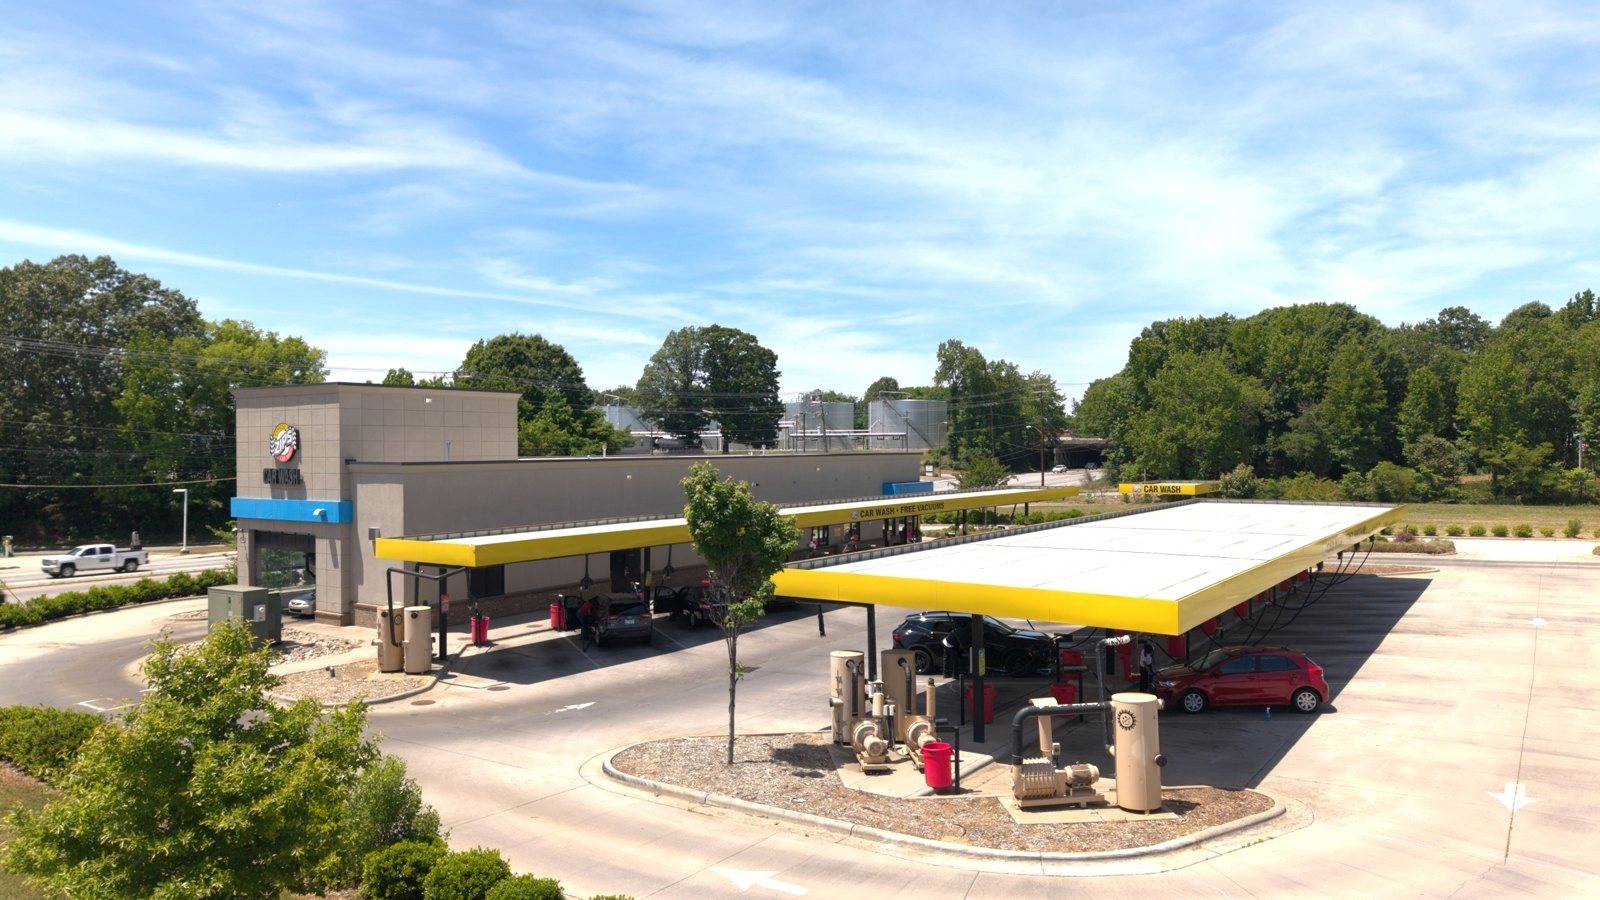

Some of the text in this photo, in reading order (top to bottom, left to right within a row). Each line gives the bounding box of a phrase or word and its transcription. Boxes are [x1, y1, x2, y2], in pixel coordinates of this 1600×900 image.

[263, 468, 300, 484] CAR WASH
[1143, 485, 1181, 493] CAR WASH
[860, 502, 945, 518] CAR WASH FREE VACUUMS
